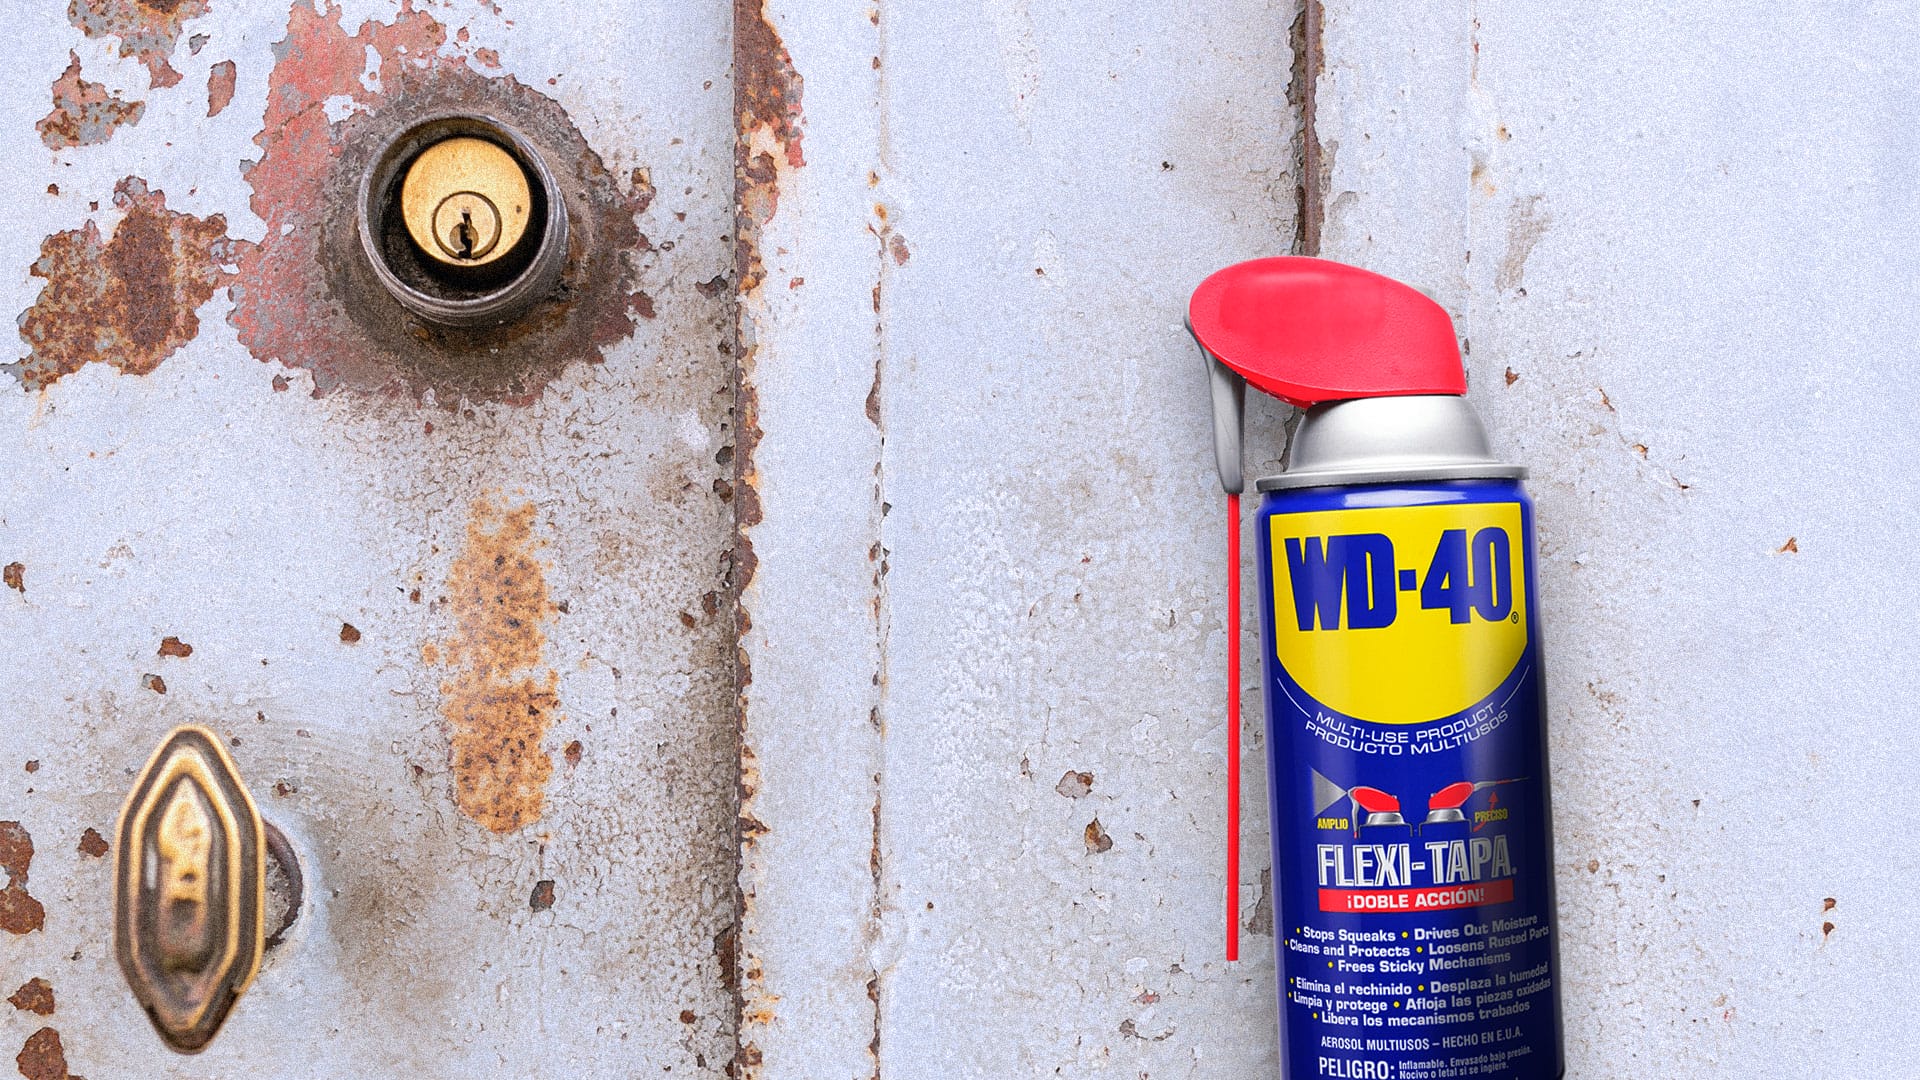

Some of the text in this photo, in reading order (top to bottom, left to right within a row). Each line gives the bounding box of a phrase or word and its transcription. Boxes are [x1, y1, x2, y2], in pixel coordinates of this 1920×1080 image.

[1284, 526, 1513, 632] WD-40
[1305, 710, 1509, 756] PRODUCTO MULTIUSOS
[1316, 702, 1494, 743] MULTI-USE PRODUCT
[1317, 818, 1349, 830] AMPLIO
[1474, 808, 1508, 823] PRECISO
[1347, 886, 1485, 910] ¡DOBLE ACCIÓN!
[1289, 925, 1549, 957] Cleans and Protects Loosens Rusted Parts
[1303, 915, 1538, 944] Stops Squeaks Drives Out Moisture
[1338, 952, 1511, 975] Frees Sticky Mechanisms
[1296, 962, 1548, 995] Elimina el rechinido Desplaza la humedad
[1293, 978, 1551, 1014] Limpia y protege Afloja las piezas oxidadas
[1321, 1001, 1530, 1026] Libera los mecanismos trabados
[1321, 1036, 1364, 1051] AEROSOL
[1366, 1038, 1430, 1051] MULTIUSOS
[1442, 1033, 1479, 1048] HECHO
[1481, 1032, 1494, 1044] EN
[1496, 1026, 1524, 1042] E.U.A.
[1319, 1056, 1395, 1080] PELIGRO:
[1399, 1059, 1448, 1070] Inflamable.
[1450, 1054, 1489, 1067] Envasado
[1489, 1051, 1506, 1063] bajo
[1399, 1070, 1429, 1080] Nocivo
[1430, 1071, 1437, 1079] o
[1438, 1067, 1458, 1078] letal
[1459, 1066, 1467, 1076] si
[1469, 1066, 1479, 1075] se
